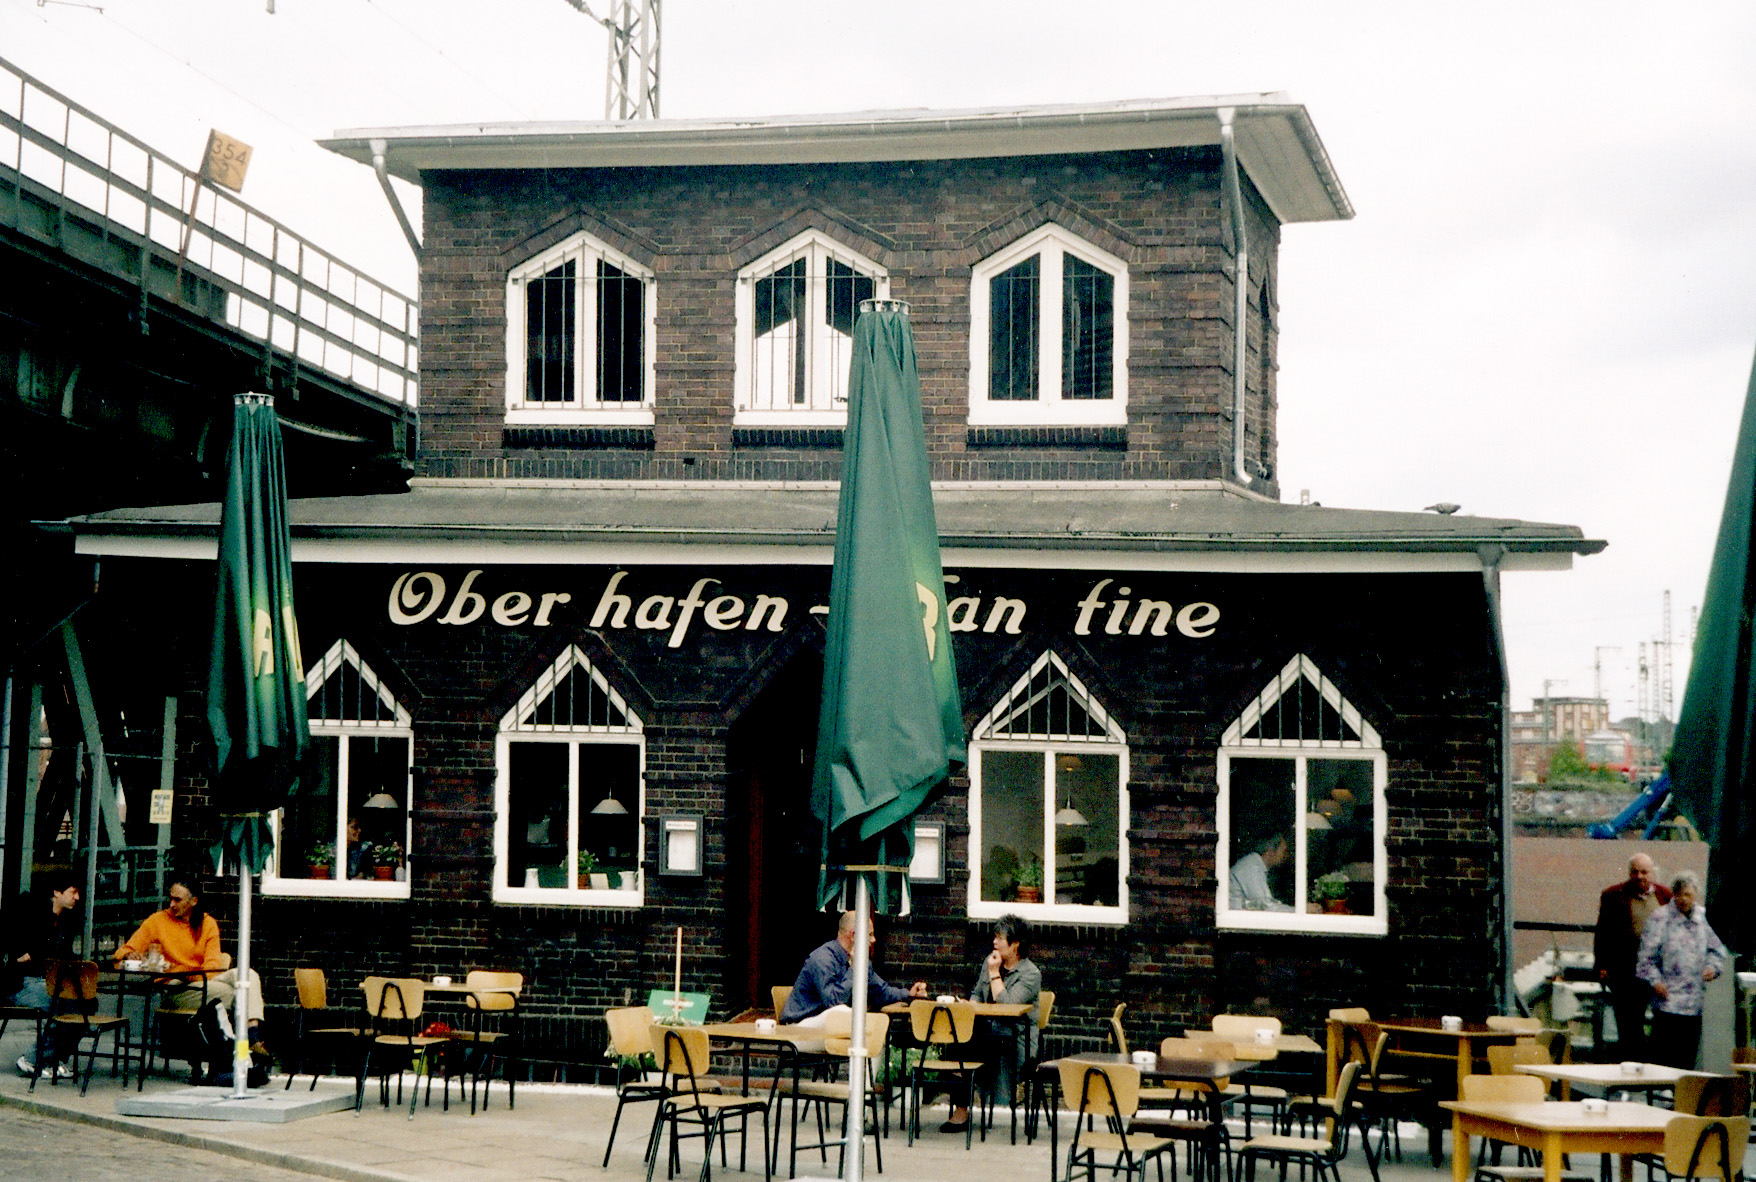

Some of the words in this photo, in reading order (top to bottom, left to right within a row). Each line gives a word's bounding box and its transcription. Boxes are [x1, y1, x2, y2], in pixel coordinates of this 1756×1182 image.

[211, 137, 248, 167] 354
[388, 570, 572, 626] Ober
[589, 571, 789, 648] hafen
[942, 574, 1027, 635] an
